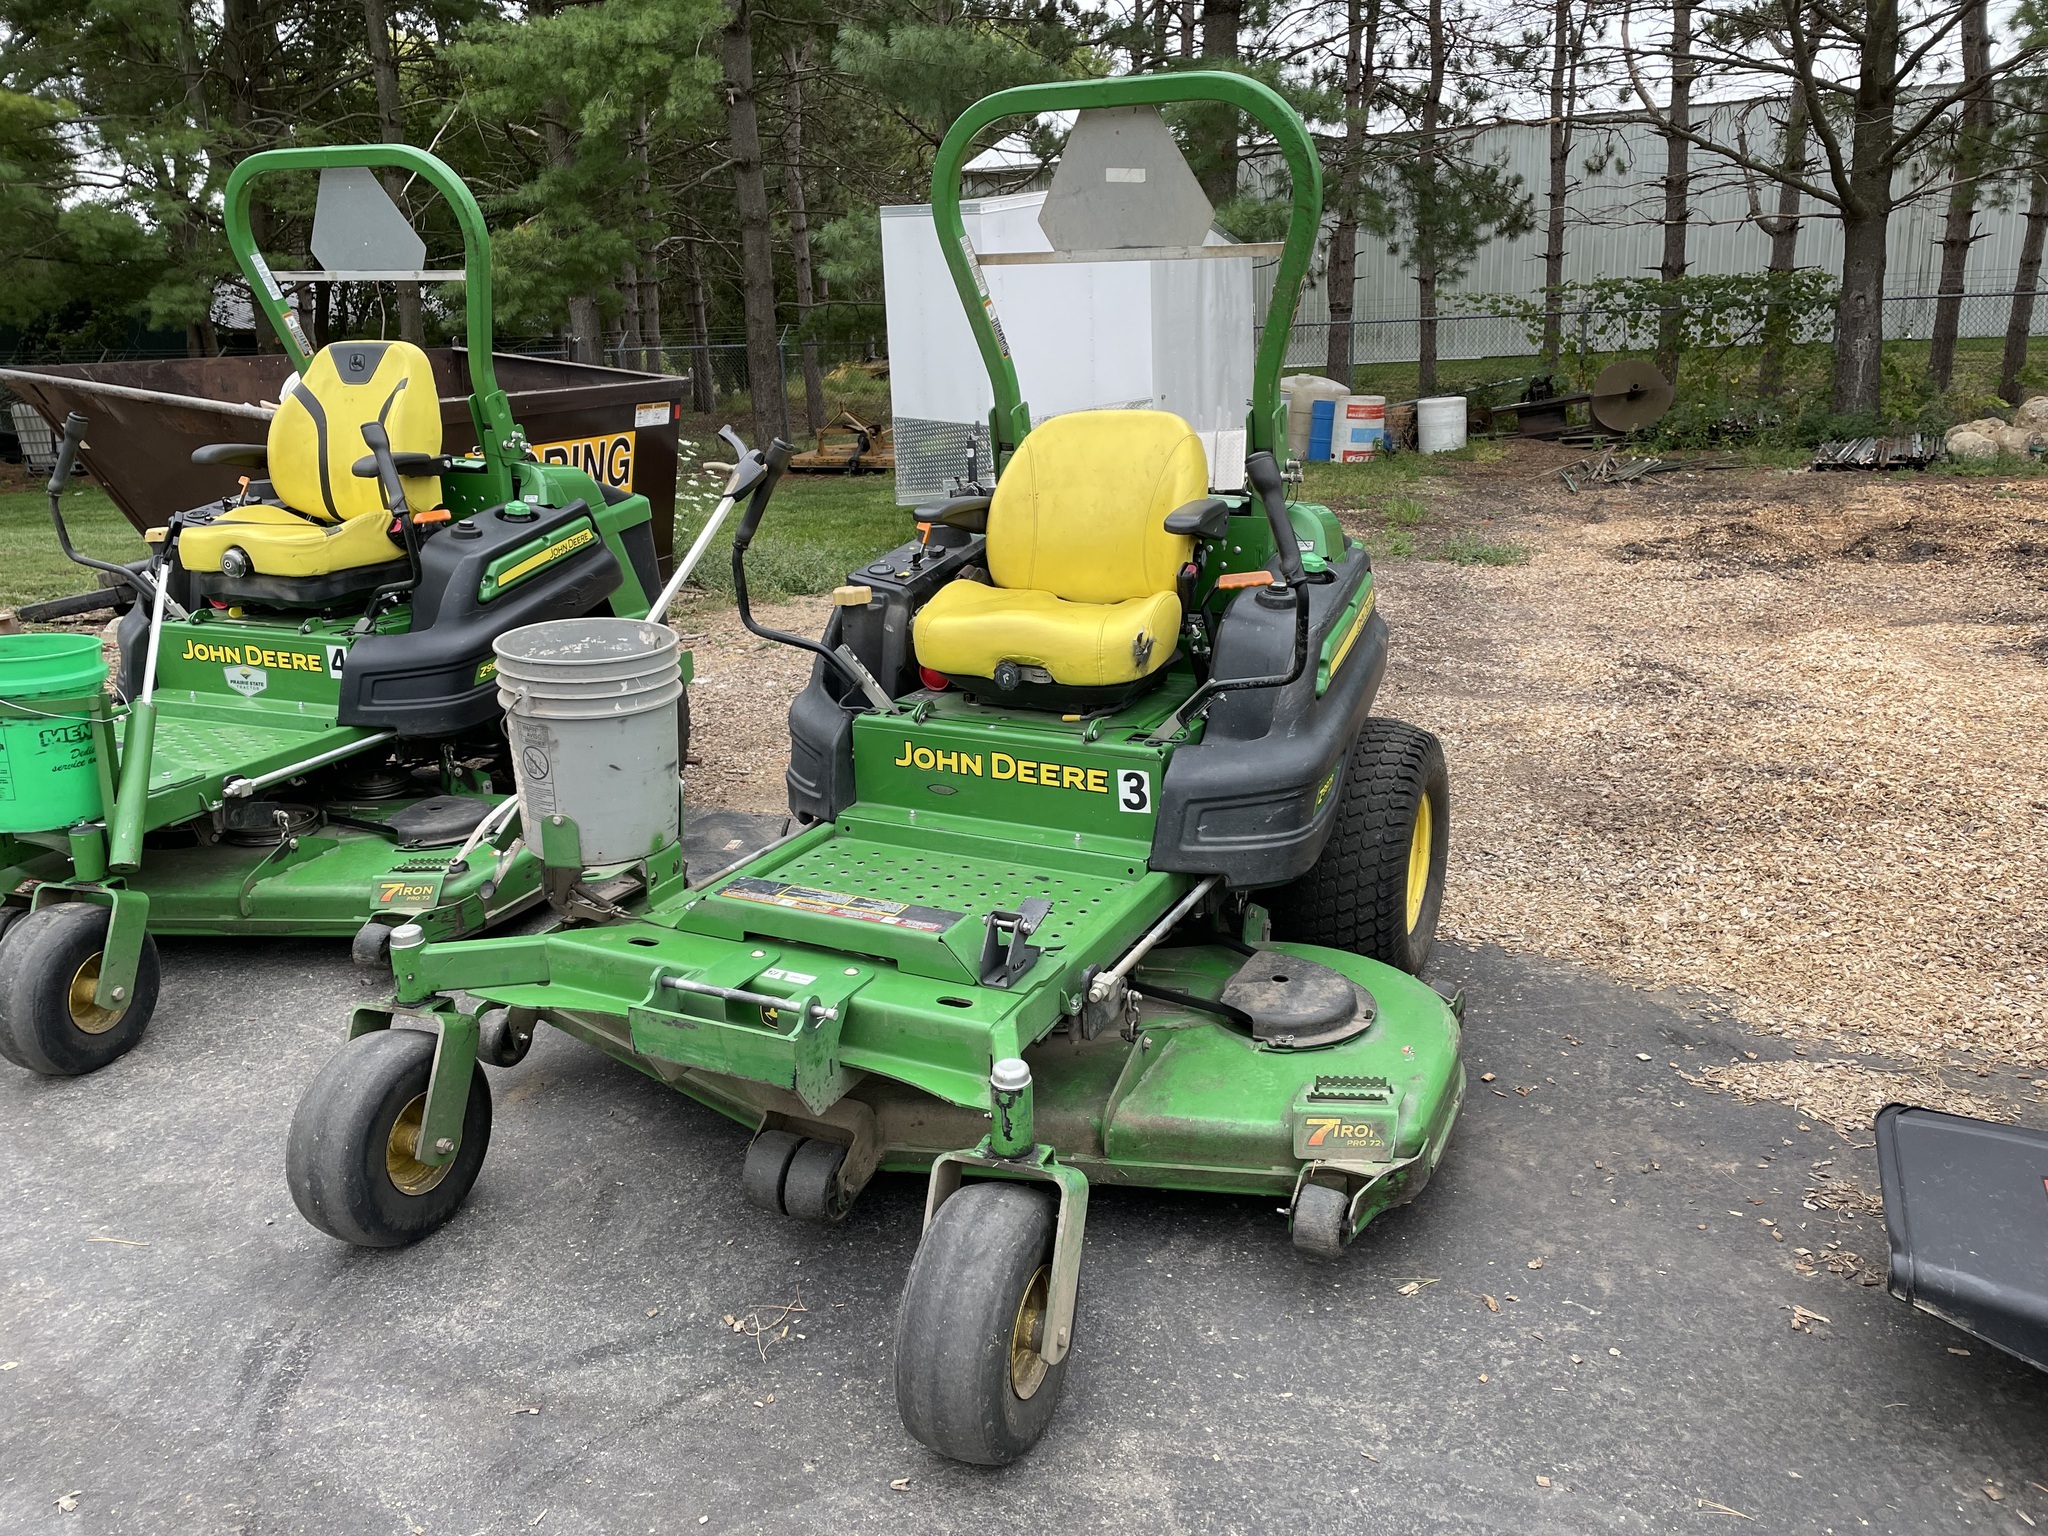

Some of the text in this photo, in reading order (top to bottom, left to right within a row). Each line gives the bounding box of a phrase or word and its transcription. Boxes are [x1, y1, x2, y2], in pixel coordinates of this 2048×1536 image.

[550, 532, 589, 559] JOHN DEERE
[182, 639, 323, 672] JOHN DEERE
[331, 648, 346, 671] 4
[52, 757, 86, 772] service
[894, 740, 1109, 794] JOHN DEERE
[1121, 772, 1148, 811] 3
